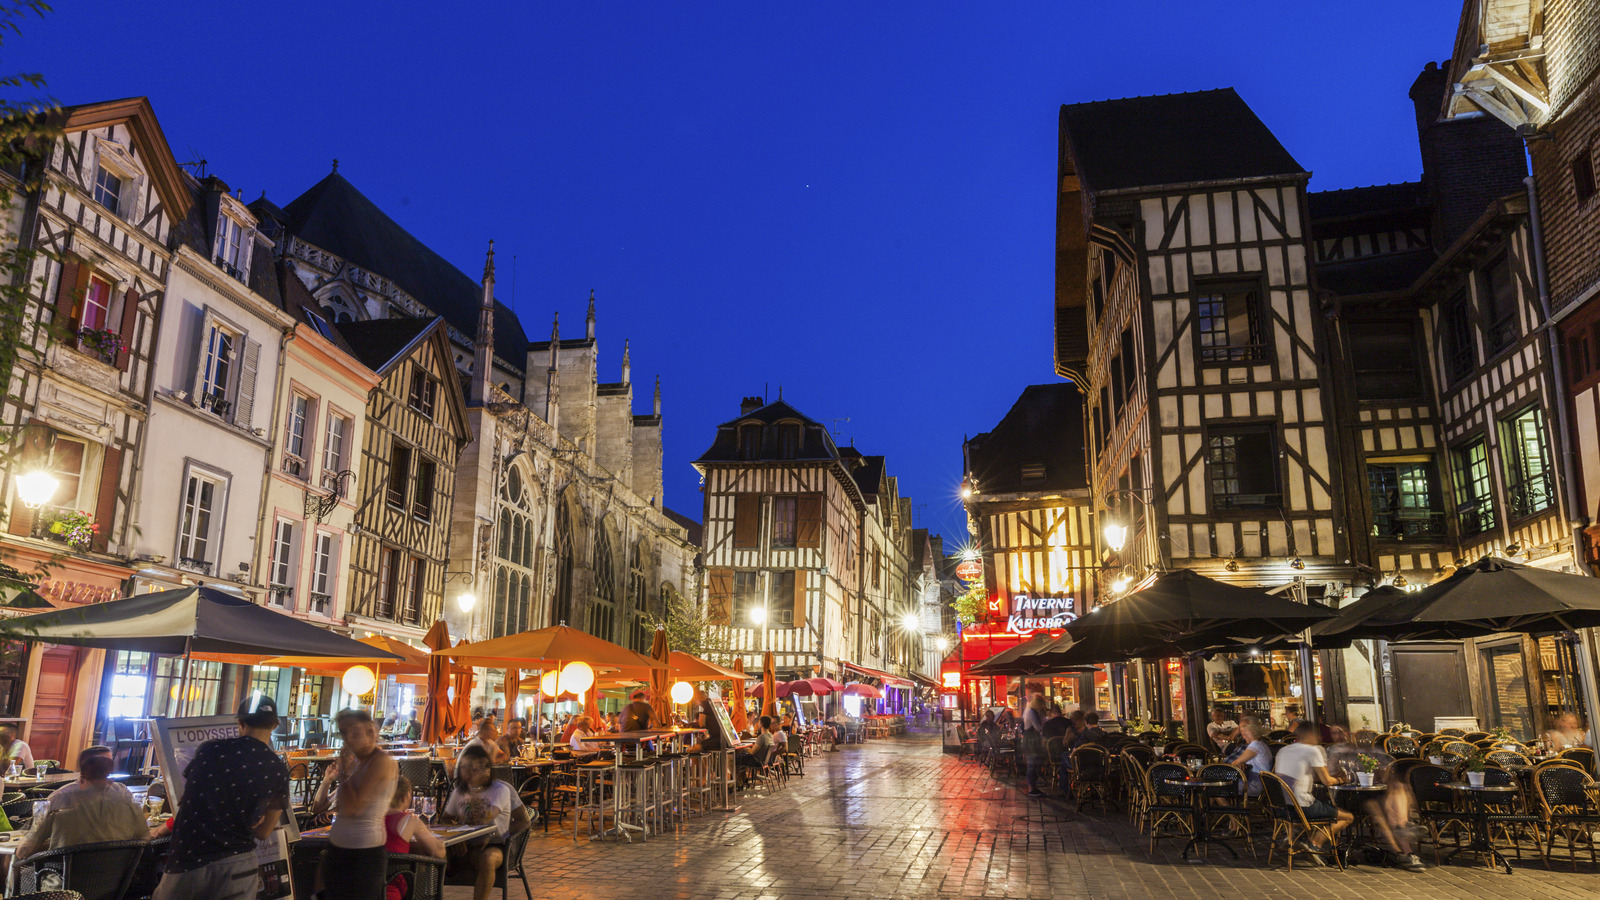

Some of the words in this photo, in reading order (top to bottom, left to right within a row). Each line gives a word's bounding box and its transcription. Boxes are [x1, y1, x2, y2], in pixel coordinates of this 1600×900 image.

[1014, 595, 1074, 611] TAVERNE
[1006, 612, 1078, 634] KARLSBRA
[1245, 701, 1254, 710] LE
[177, 727, 239, 743] L'ODYSSEE
